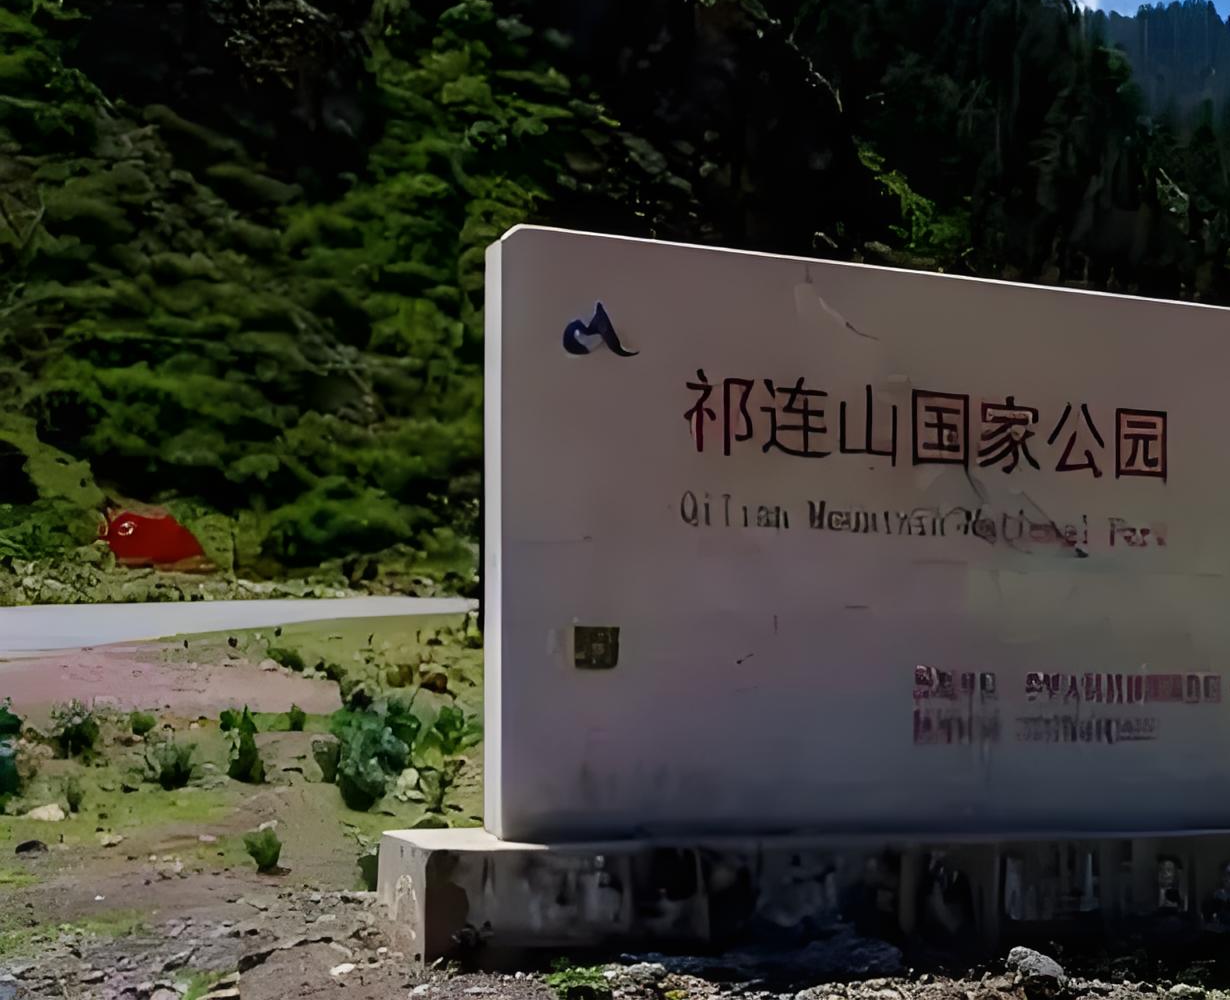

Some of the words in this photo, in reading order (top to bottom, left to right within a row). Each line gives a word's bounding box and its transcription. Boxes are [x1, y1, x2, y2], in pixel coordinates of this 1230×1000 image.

[684, 369, 1168, 485] 祁连山国家公园
[1108, 516, 1168, 548] Par
